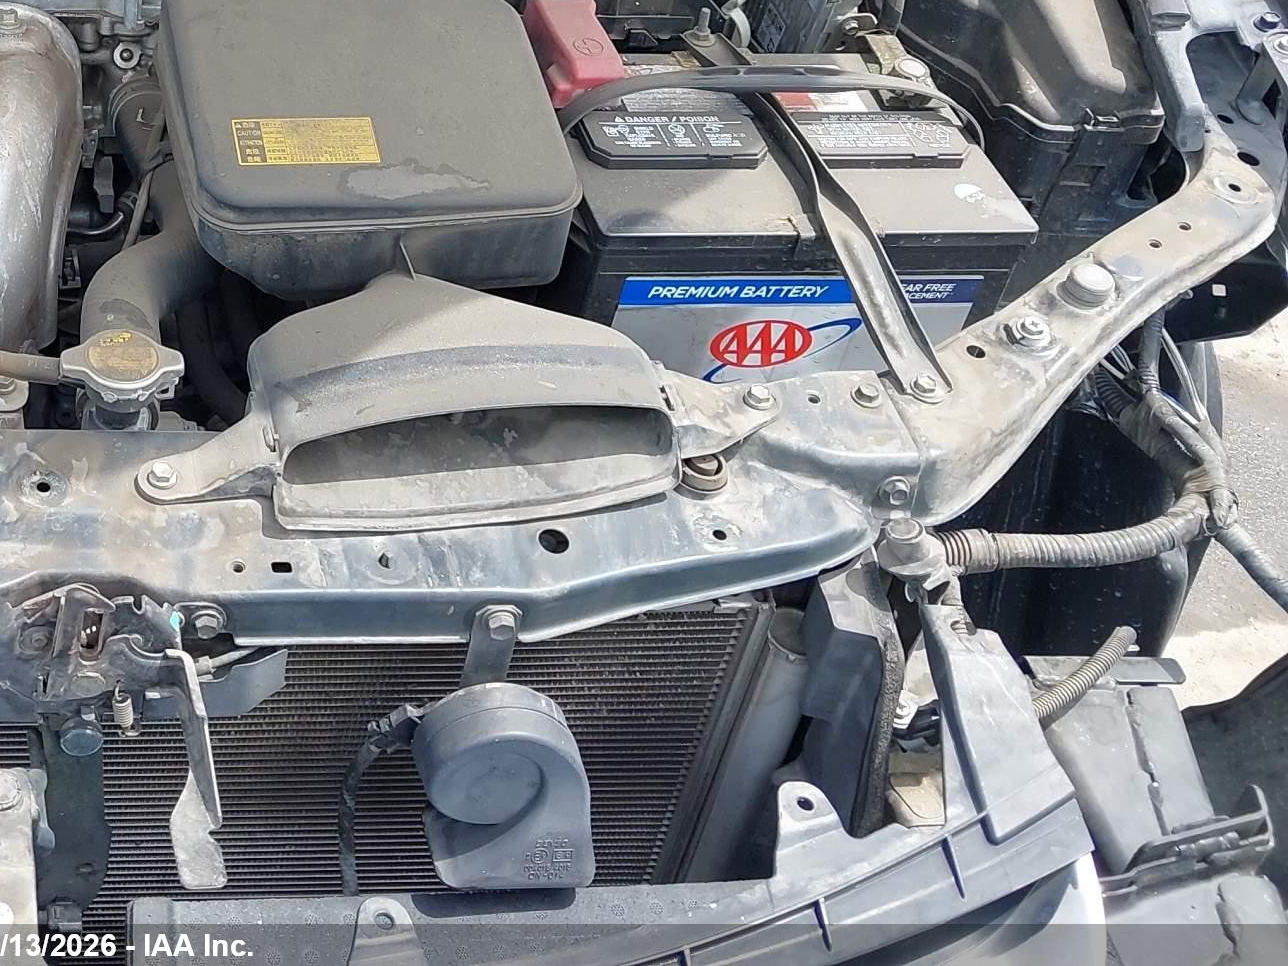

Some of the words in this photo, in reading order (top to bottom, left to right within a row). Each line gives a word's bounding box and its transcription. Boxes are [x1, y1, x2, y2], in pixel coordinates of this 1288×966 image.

[625, 115, 669, 123] DANGER
[679, 115, 720, 123] POISON
[647, 285, 740, 299] PREMIUM
[743, 285, 830, 299] BATTERY
[901, 283, 924, 292] EAR
[924, 283, 957, 292] FREE
[711, 319, 812, 369] AAA
